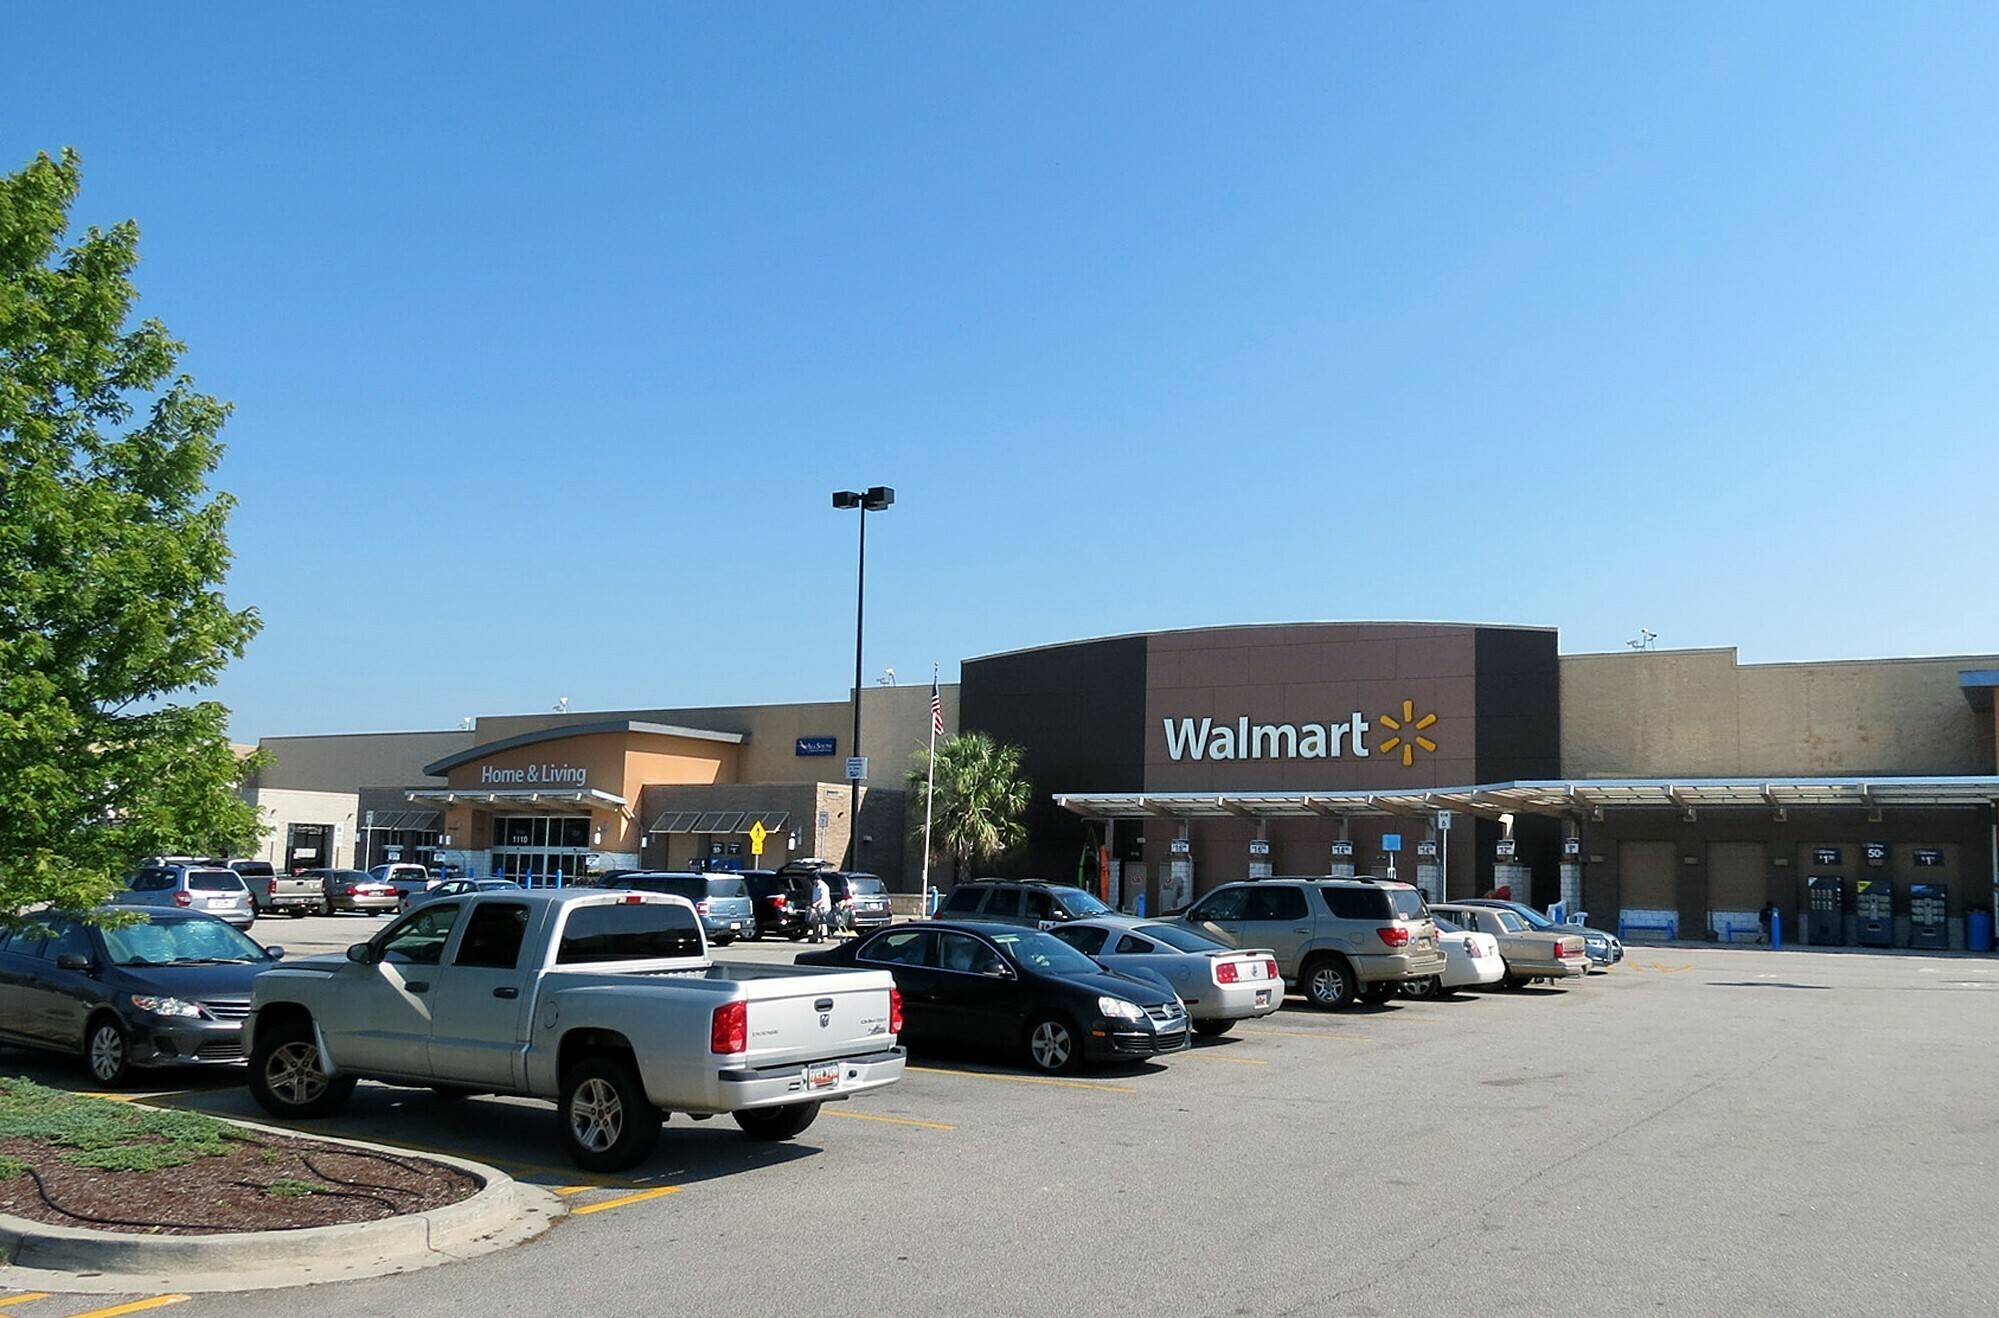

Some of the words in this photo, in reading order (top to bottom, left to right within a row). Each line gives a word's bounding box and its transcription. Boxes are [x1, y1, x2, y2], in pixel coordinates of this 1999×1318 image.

[1163, 711, 1370, 760] Walmart
[481, 765, 524, 783] Home
[526, 764, 539, 782] &
[542, 763, 587, 787] Living
